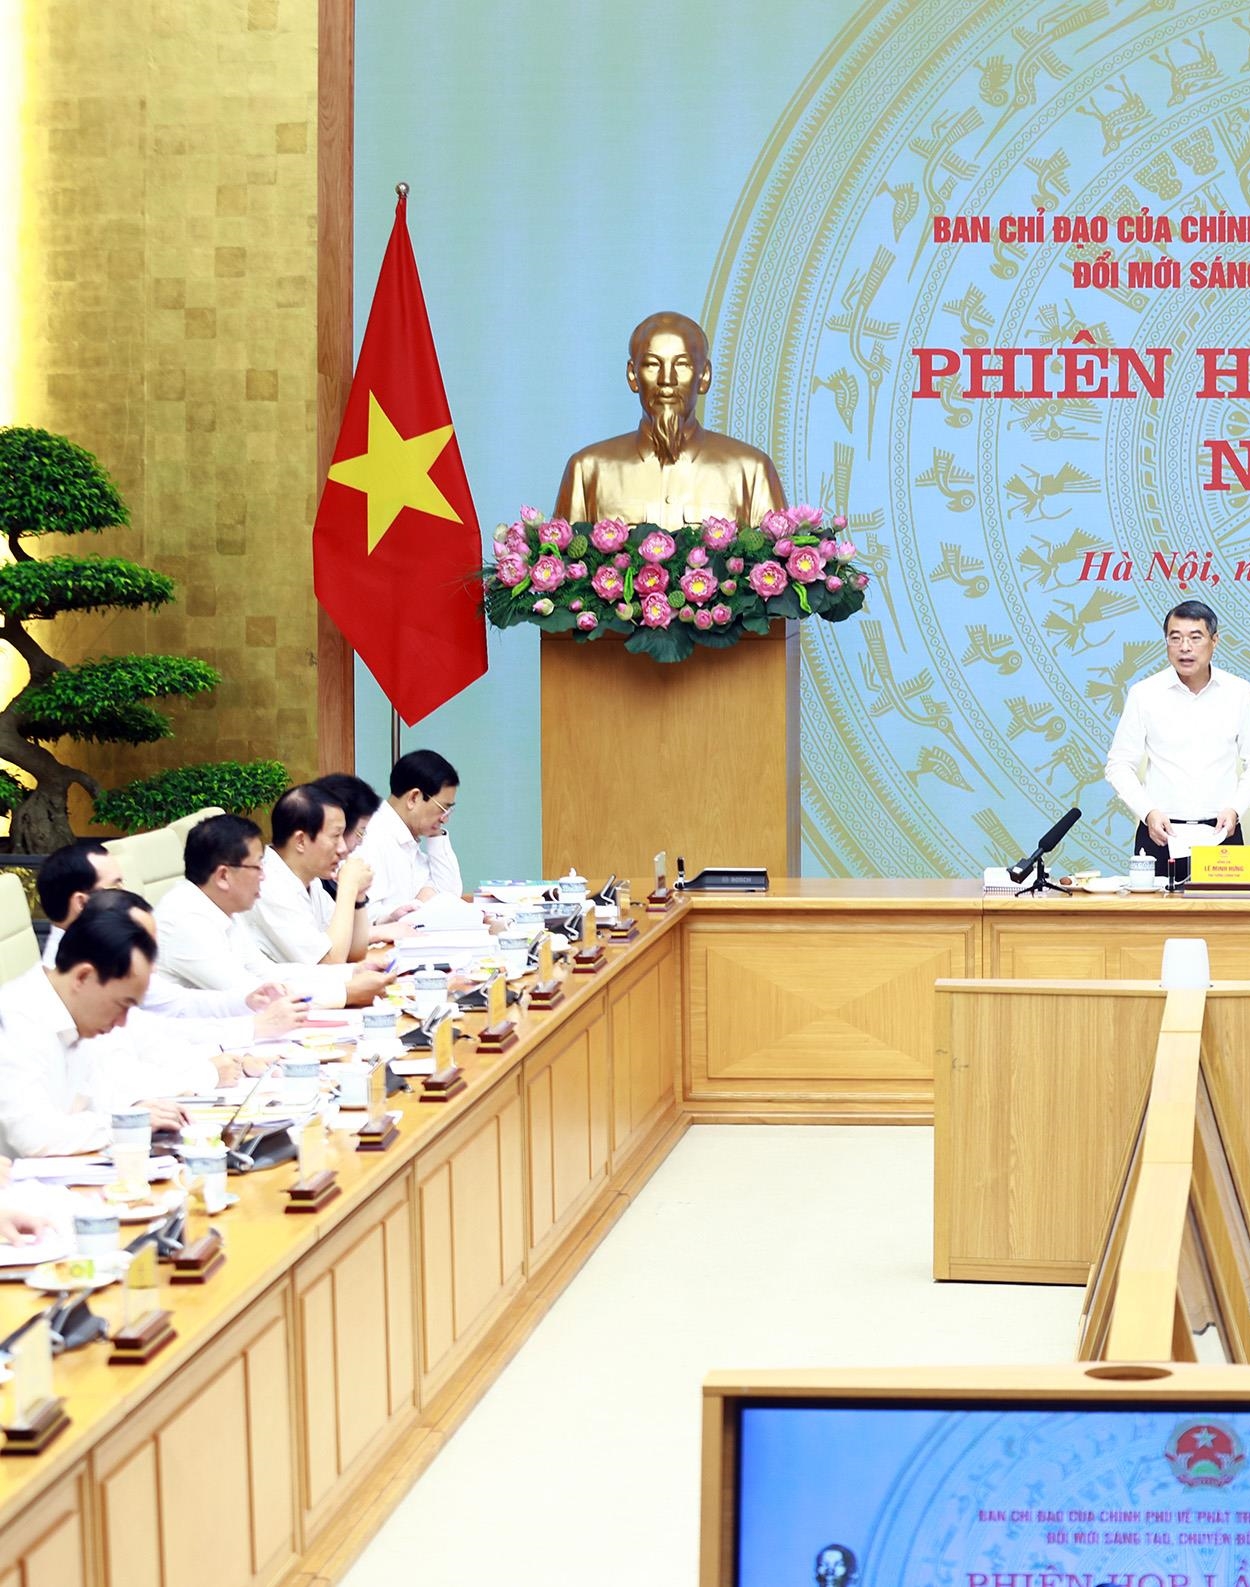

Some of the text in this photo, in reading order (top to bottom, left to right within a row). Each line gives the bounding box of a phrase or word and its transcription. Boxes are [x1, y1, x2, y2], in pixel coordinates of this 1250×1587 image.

[934, 216, 990, 244] BAN
[999, 207, 1046, 244] CHỈ
[1053, 216, 1110, 251] ĐẠO
[1117, 207, 1172, 244] CỦA
[1073, 250, 1119, 290] ĐỔI
[1128, 254, 1181, 290] MỚI
[911, 329, 1172, 400] PHIÊN
[1079, 551, 1134, 582] Hà
[1145, 550, 1220, 590] Nội,
